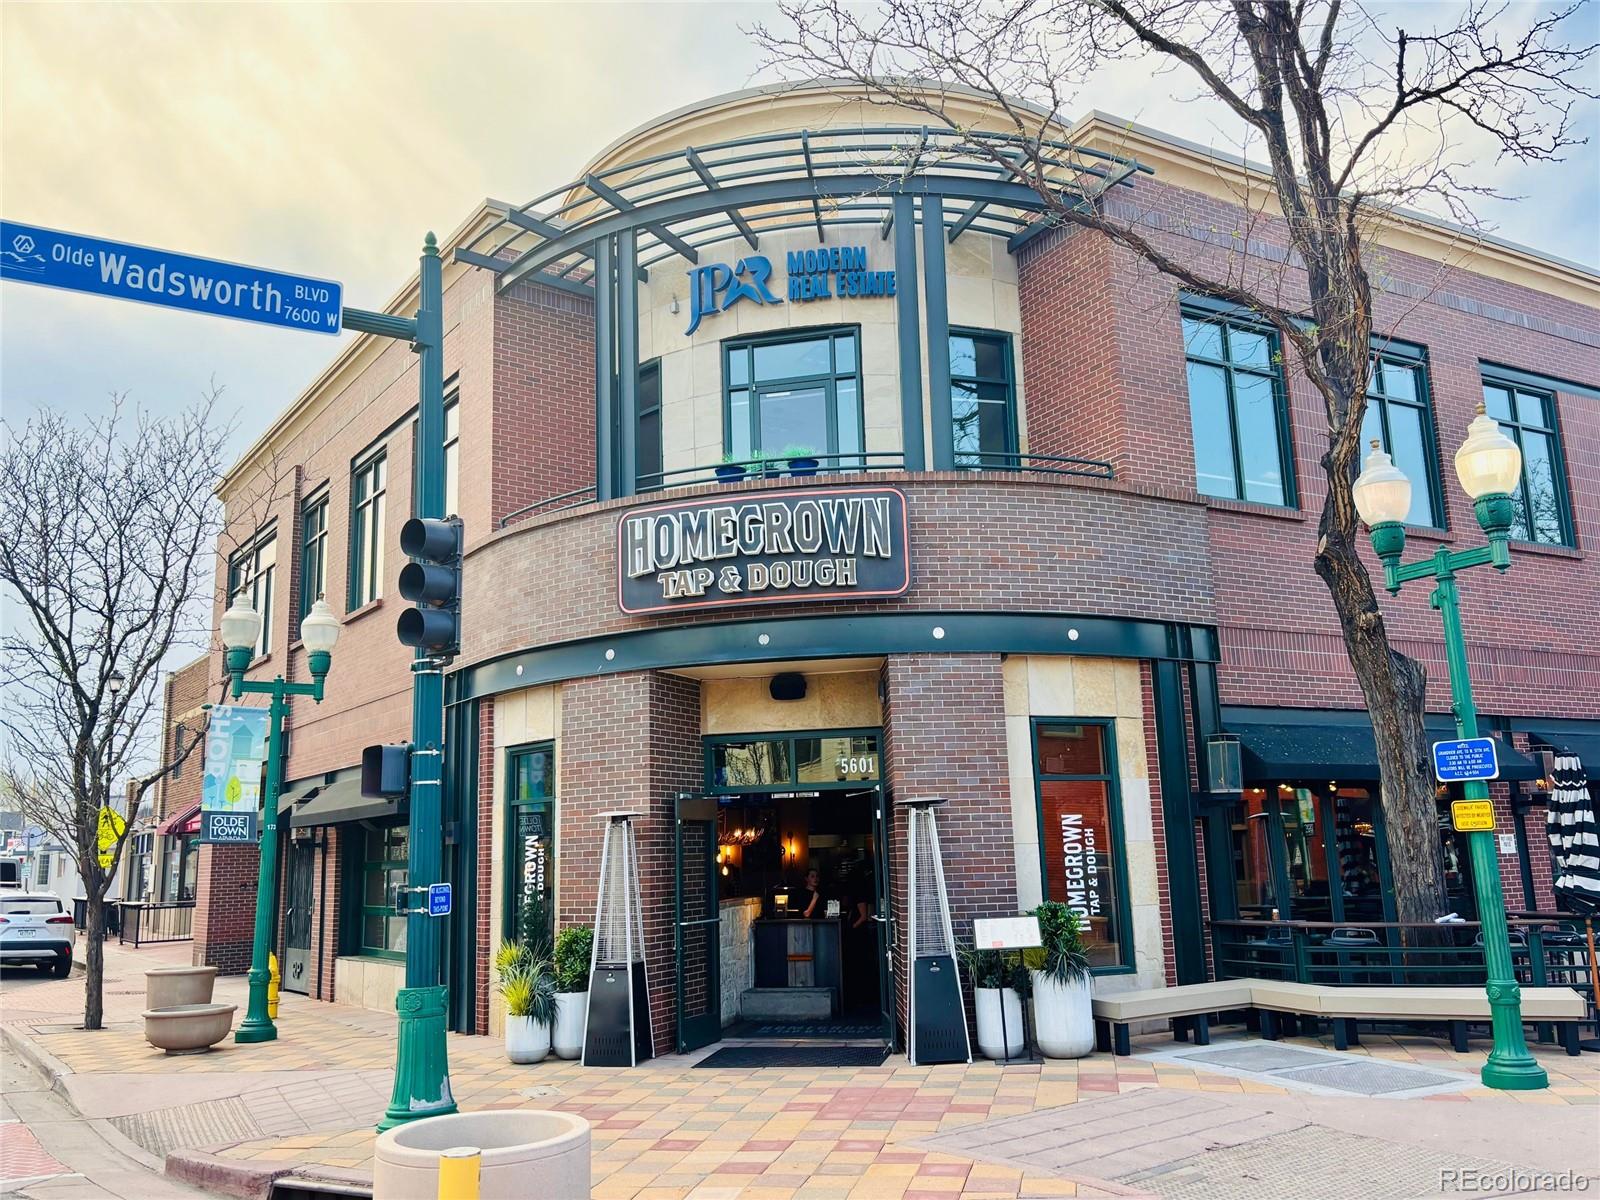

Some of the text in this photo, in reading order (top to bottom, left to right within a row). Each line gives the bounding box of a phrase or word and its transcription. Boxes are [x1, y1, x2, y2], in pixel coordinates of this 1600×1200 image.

[786, 246, 867, 274] MODERN
[52, 243, 282, 314] Olde Wadsworth
[788, 270, 896, 302] REAL ESTATE
[294, 285, 329, 304] BLVD
[284, 305, 338, 327] 7600 W
[627, 497, 892, 579] HOMEGROWN
[657, 558, 858, 599] TAP & DOUGH
[841, 757, 874, 774] 5601
[211, 826, 247, 836] TOWN
[214, 816, 245, 827] OLDE
[537, 848, 545, 891] DOUGH
[1084, 828, 1101, 916] TAP & DOUGH
